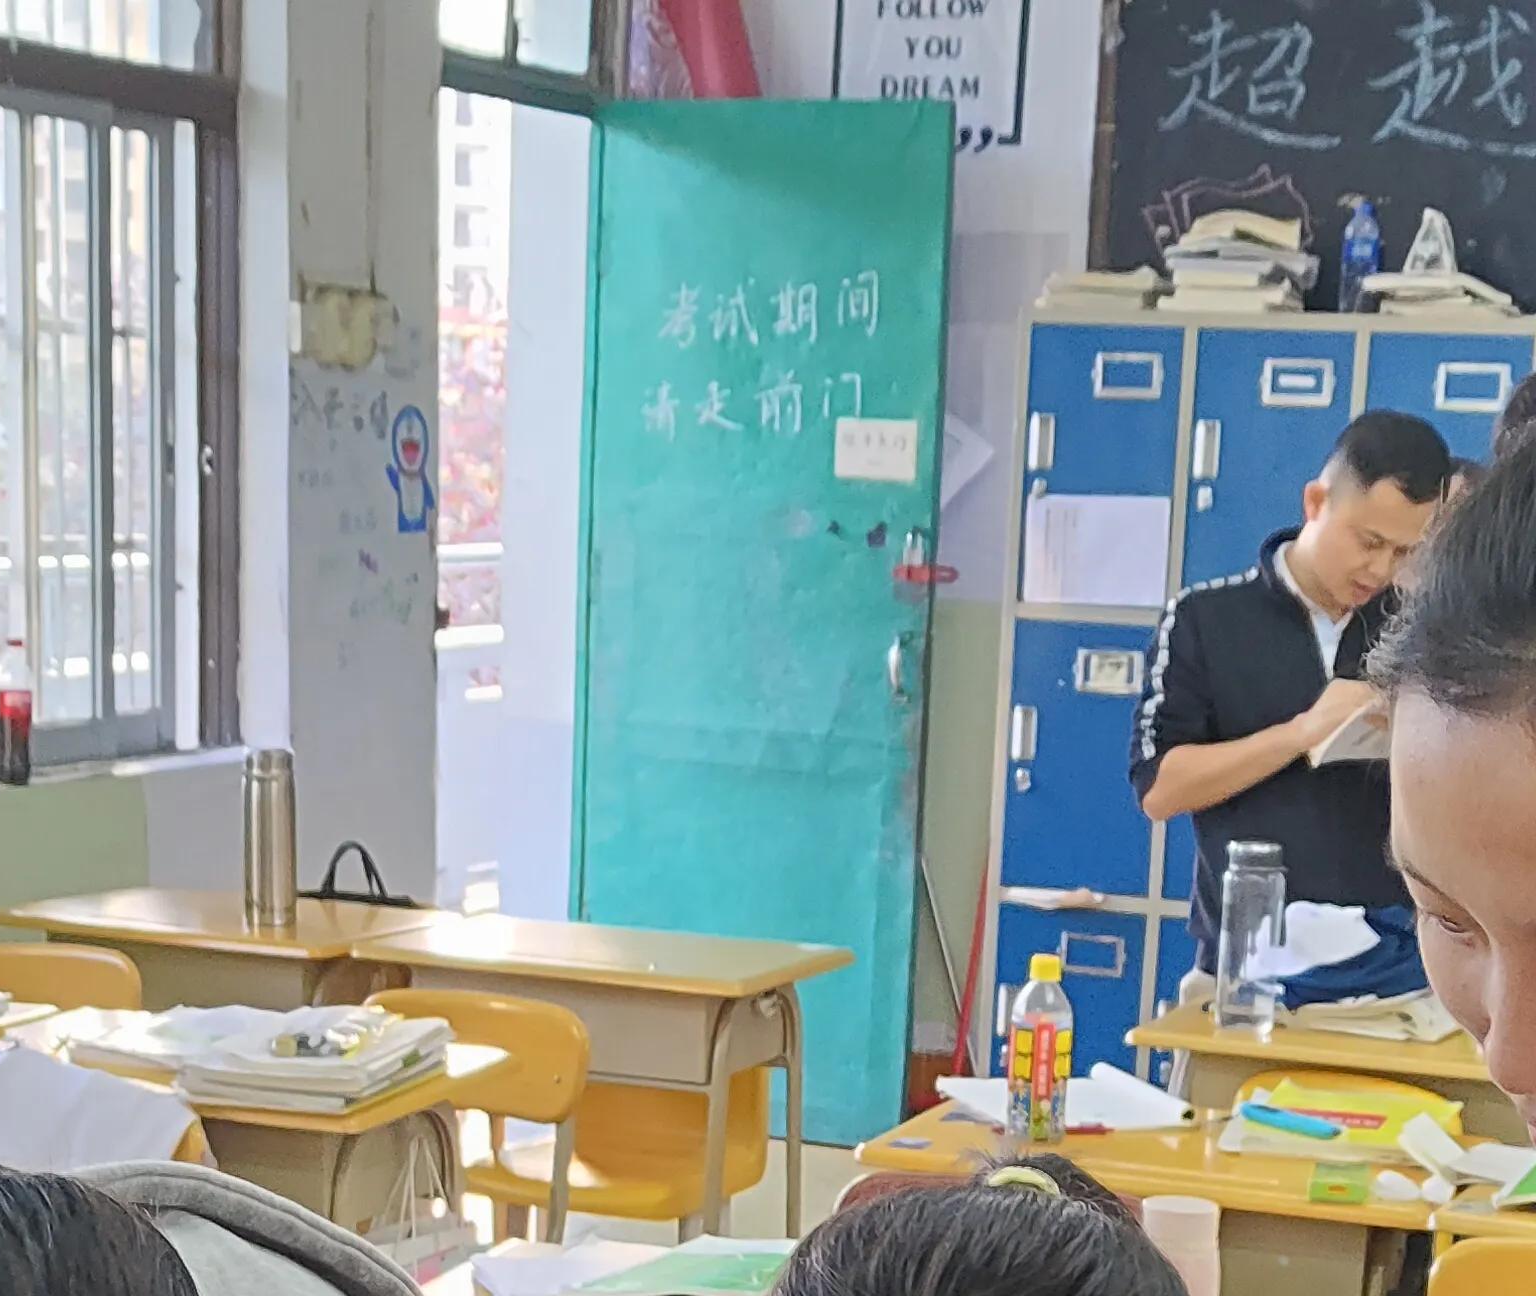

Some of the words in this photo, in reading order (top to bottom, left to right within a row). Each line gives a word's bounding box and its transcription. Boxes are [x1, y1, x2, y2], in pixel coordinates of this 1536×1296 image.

[906, 36, 963, 59] YOU
[880, 75, 980, 99] DREAM
[658, 269, 879, 349] 考试期间
[641, 369, 862, 443] 请走前门
